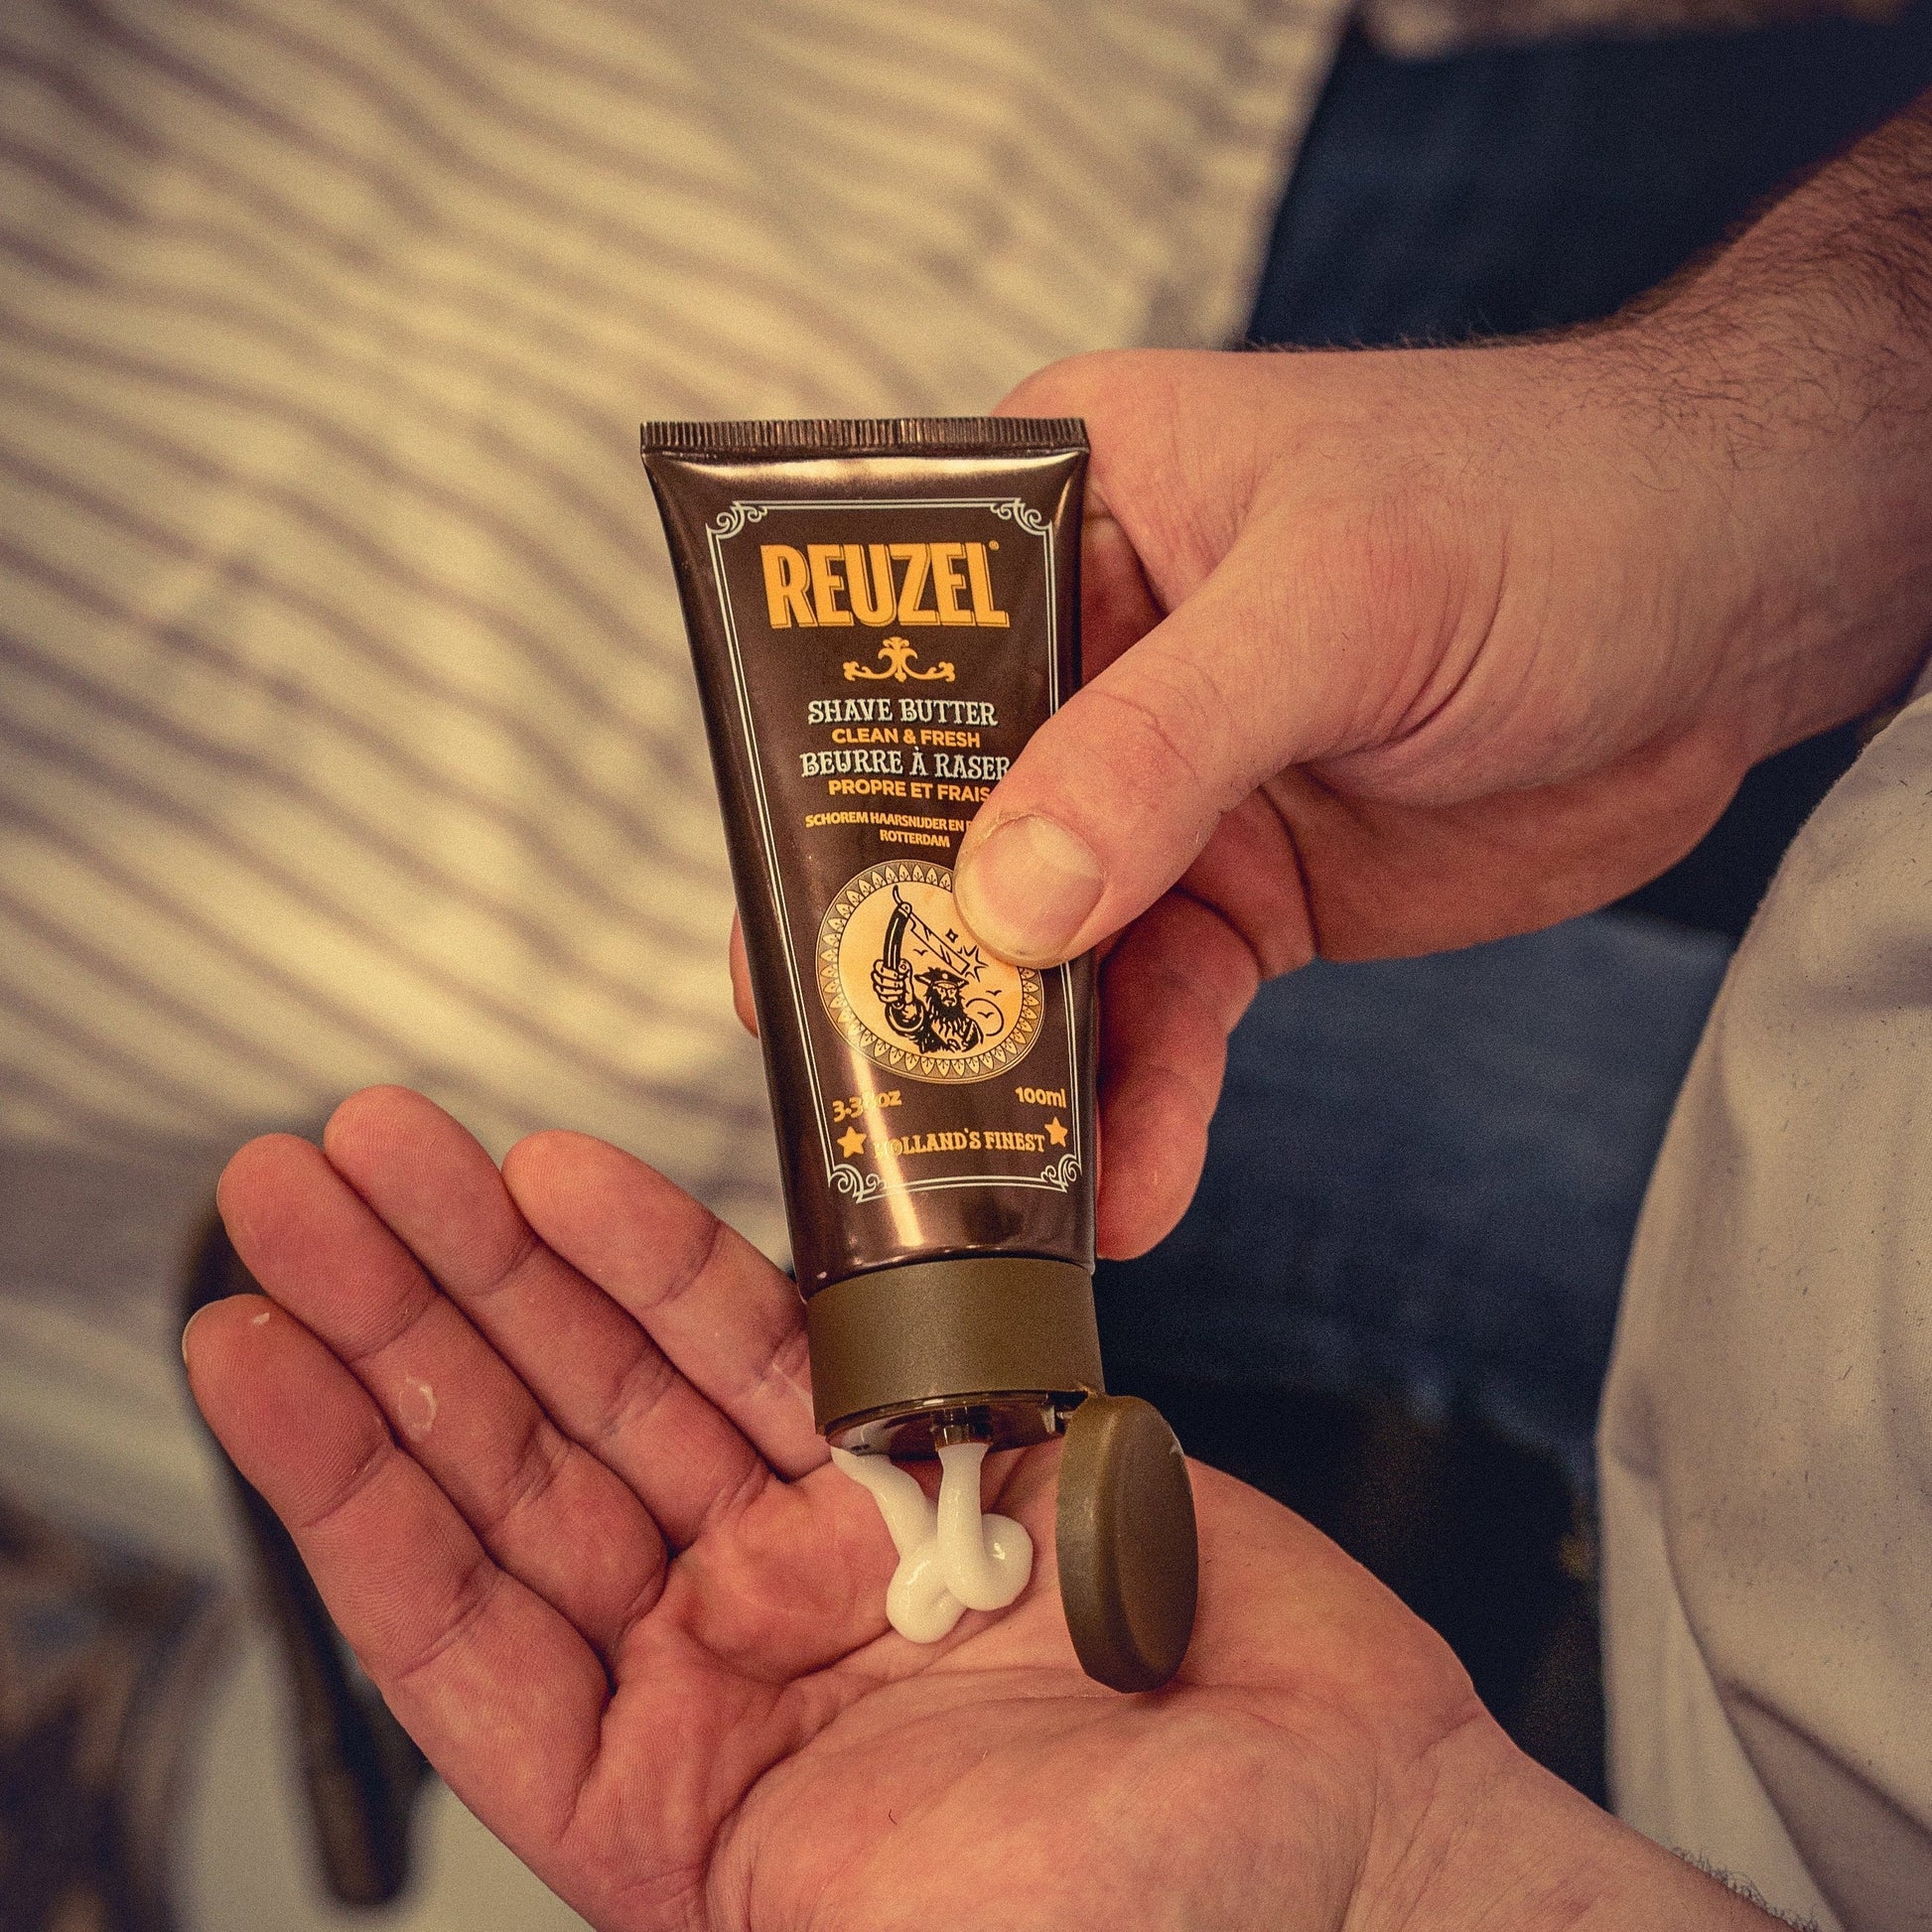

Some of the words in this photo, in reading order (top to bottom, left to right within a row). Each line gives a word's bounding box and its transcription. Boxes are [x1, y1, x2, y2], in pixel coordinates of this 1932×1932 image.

[759, 542, 1010, 628] REUZEL
[807, 698, 893, 725] SHAVE
[897, 698, 998, 727] BUTTER
[832, 728, 898, 745] CLEAN
[902, 729, 916, 745] &
[920, 730, 980, 748] FRESH
[799, 750, 903, 777] BEURRE
[909, 747, 928, 776] À
[828, 779, 906, 796] PROPRE
[909, 782, 933, 799] ET
[937, 784, 991, 802] FRAIS
[805, 811, 869, 828] SCHOREM
[948, 819, 964, 832] EN
[880, 829, 950, 848] ROTTERDAM
[832, 1090, 902, 1123] 3.3oz
[1016, 1086, 1067, 1109] 100ml
[984, 1131, 1045, 1153] FINEST
